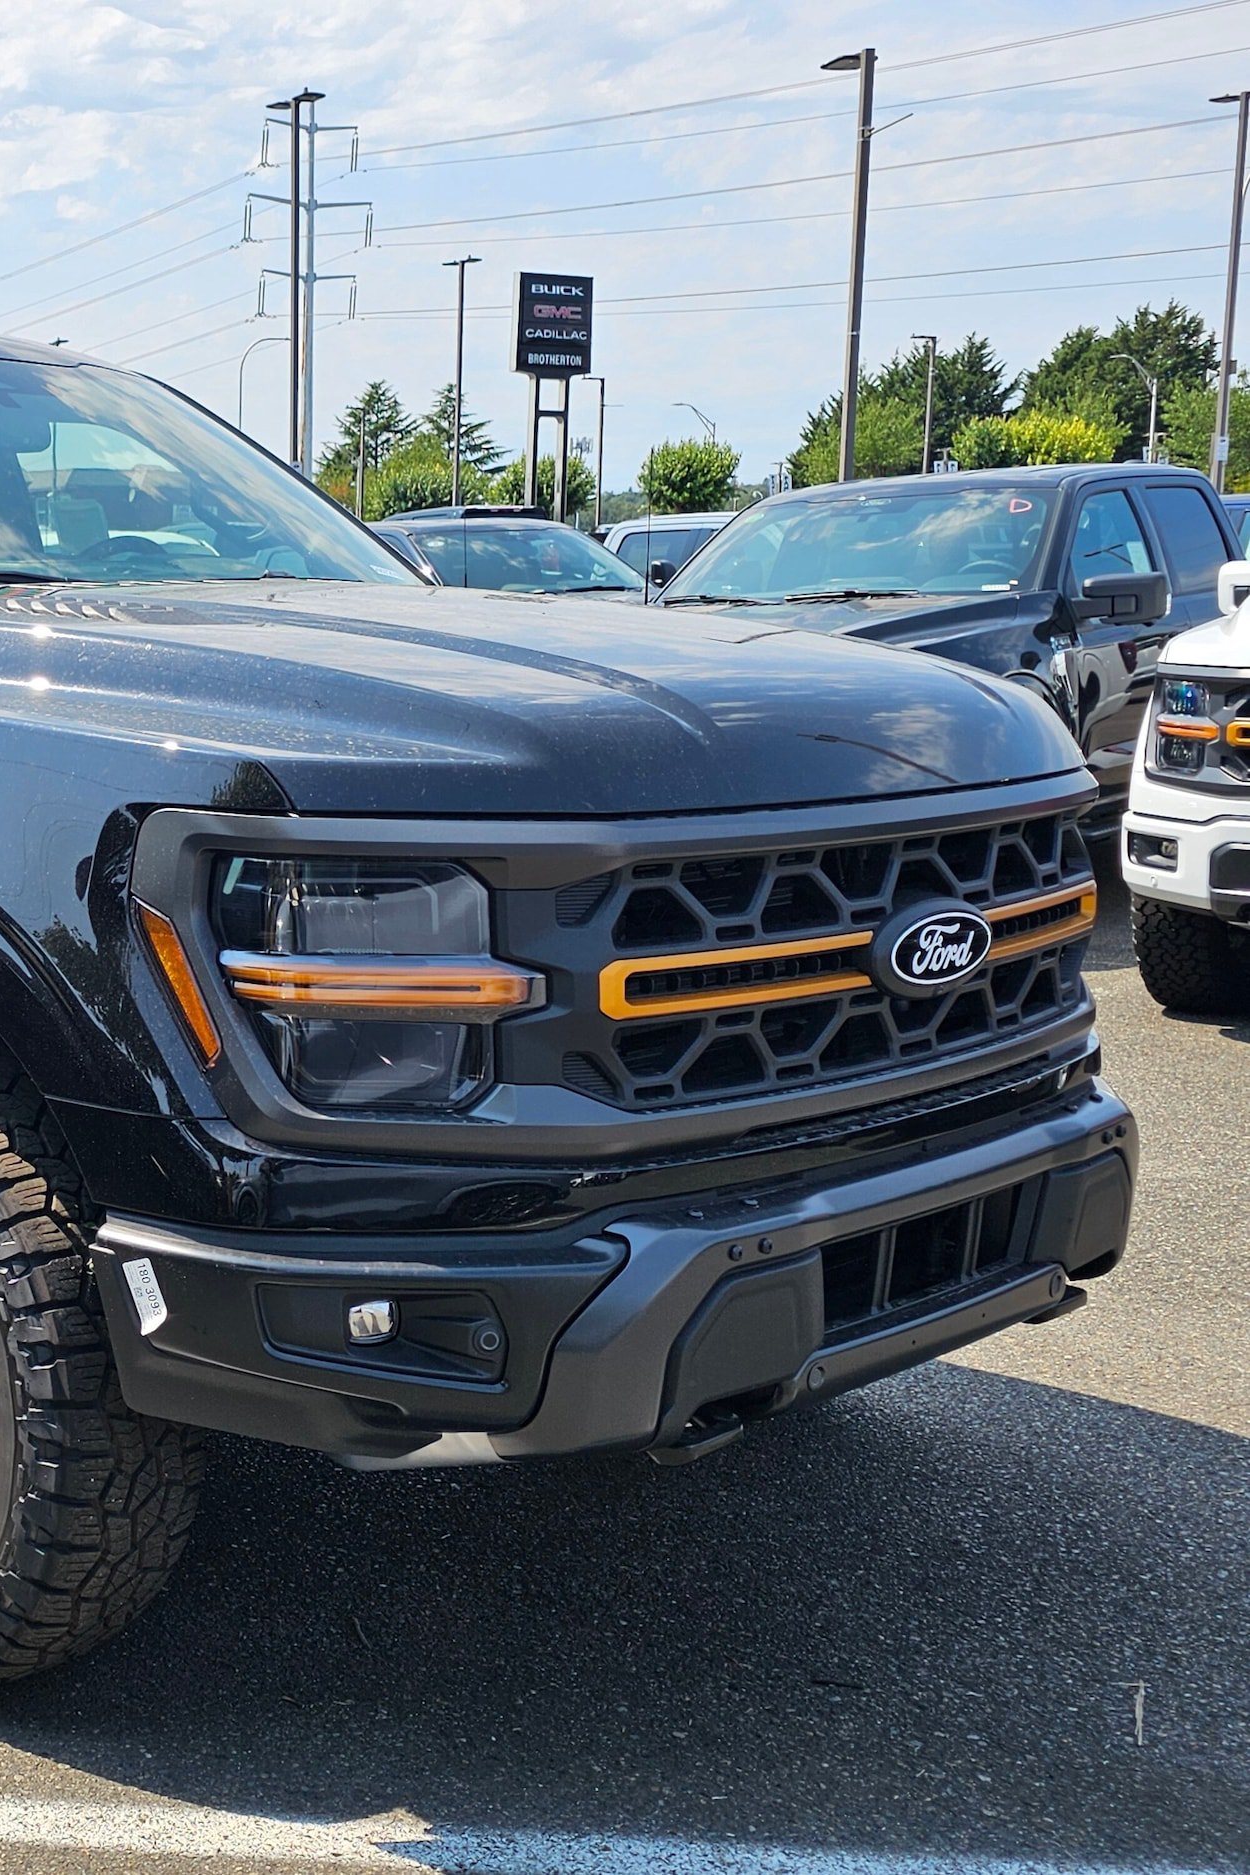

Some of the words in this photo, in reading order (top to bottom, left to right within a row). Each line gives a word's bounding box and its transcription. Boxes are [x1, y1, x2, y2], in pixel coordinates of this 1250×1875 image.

[531, 284, 584, 296] BUICK
[534, 304, 582, 319] GMC
[525, 328, 587, 340] CADILLAC
[528, 353, 582, 366] BROTHERTON
[912, 923, 975, 975] Ford
[137, 1264, 151, 1284] 180
[145, 1287, 163, 1316] 3093
